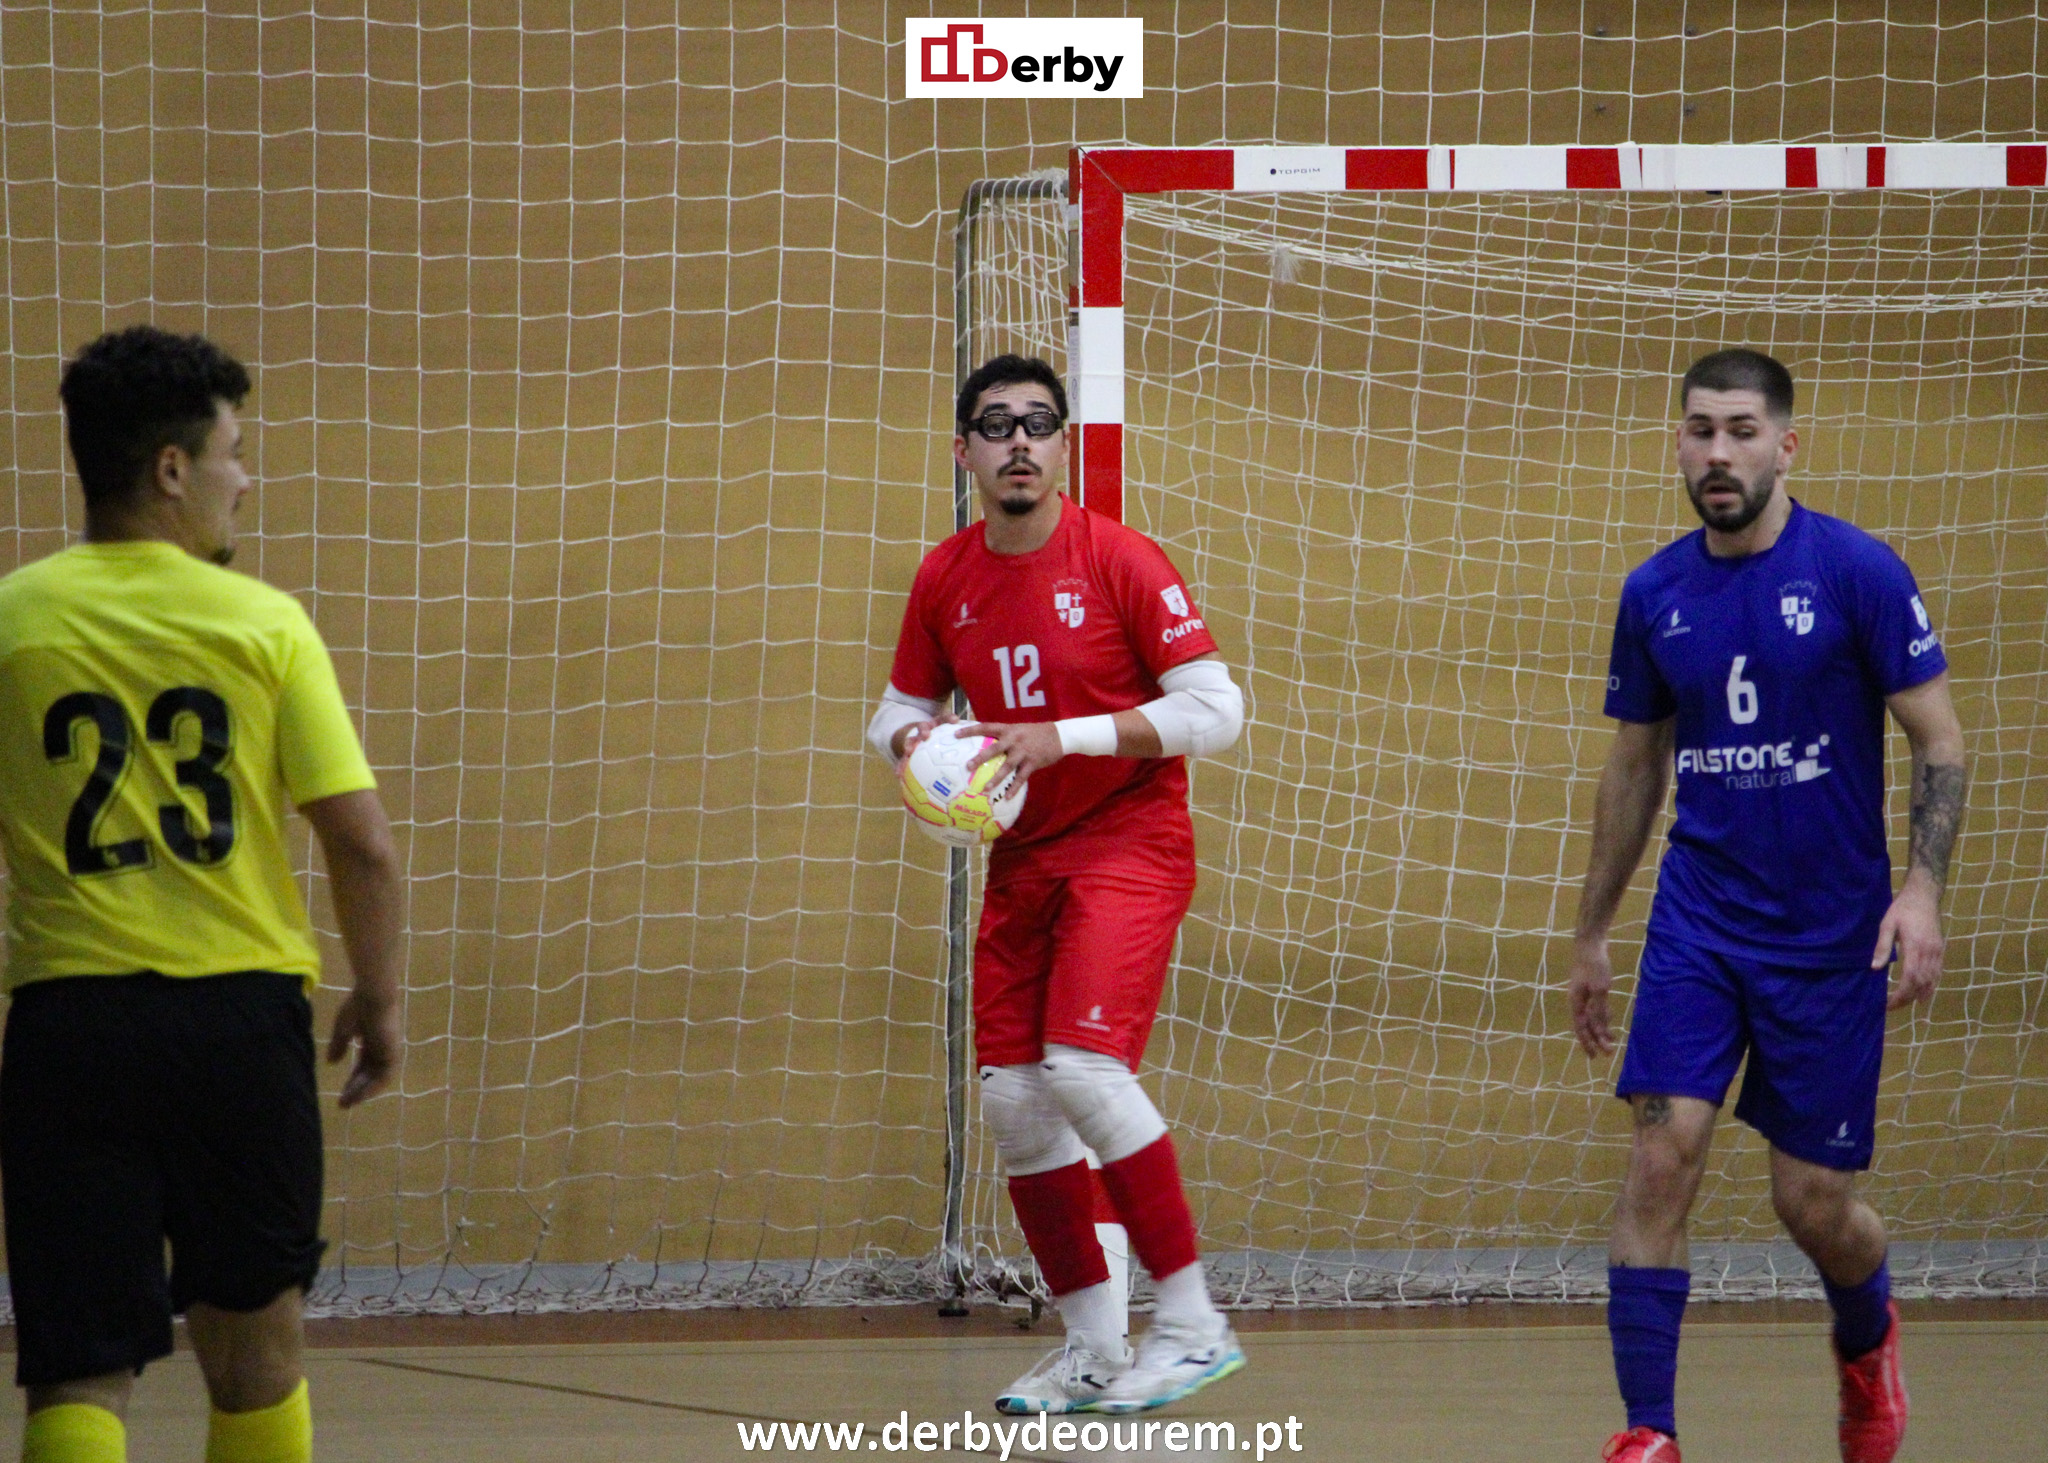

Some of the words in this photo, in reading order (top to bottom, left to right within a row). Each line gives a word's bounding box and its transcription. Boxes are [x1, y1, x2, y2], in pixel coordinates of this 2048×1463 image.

[992, 643, 1047, 710] 12
[1725, 655, 1760, 726] 6
[43, 686, 236, 877] 23
[1677, 741, 1794, 774] FILSTONE
[1725, 765, 1796, 791] natural
